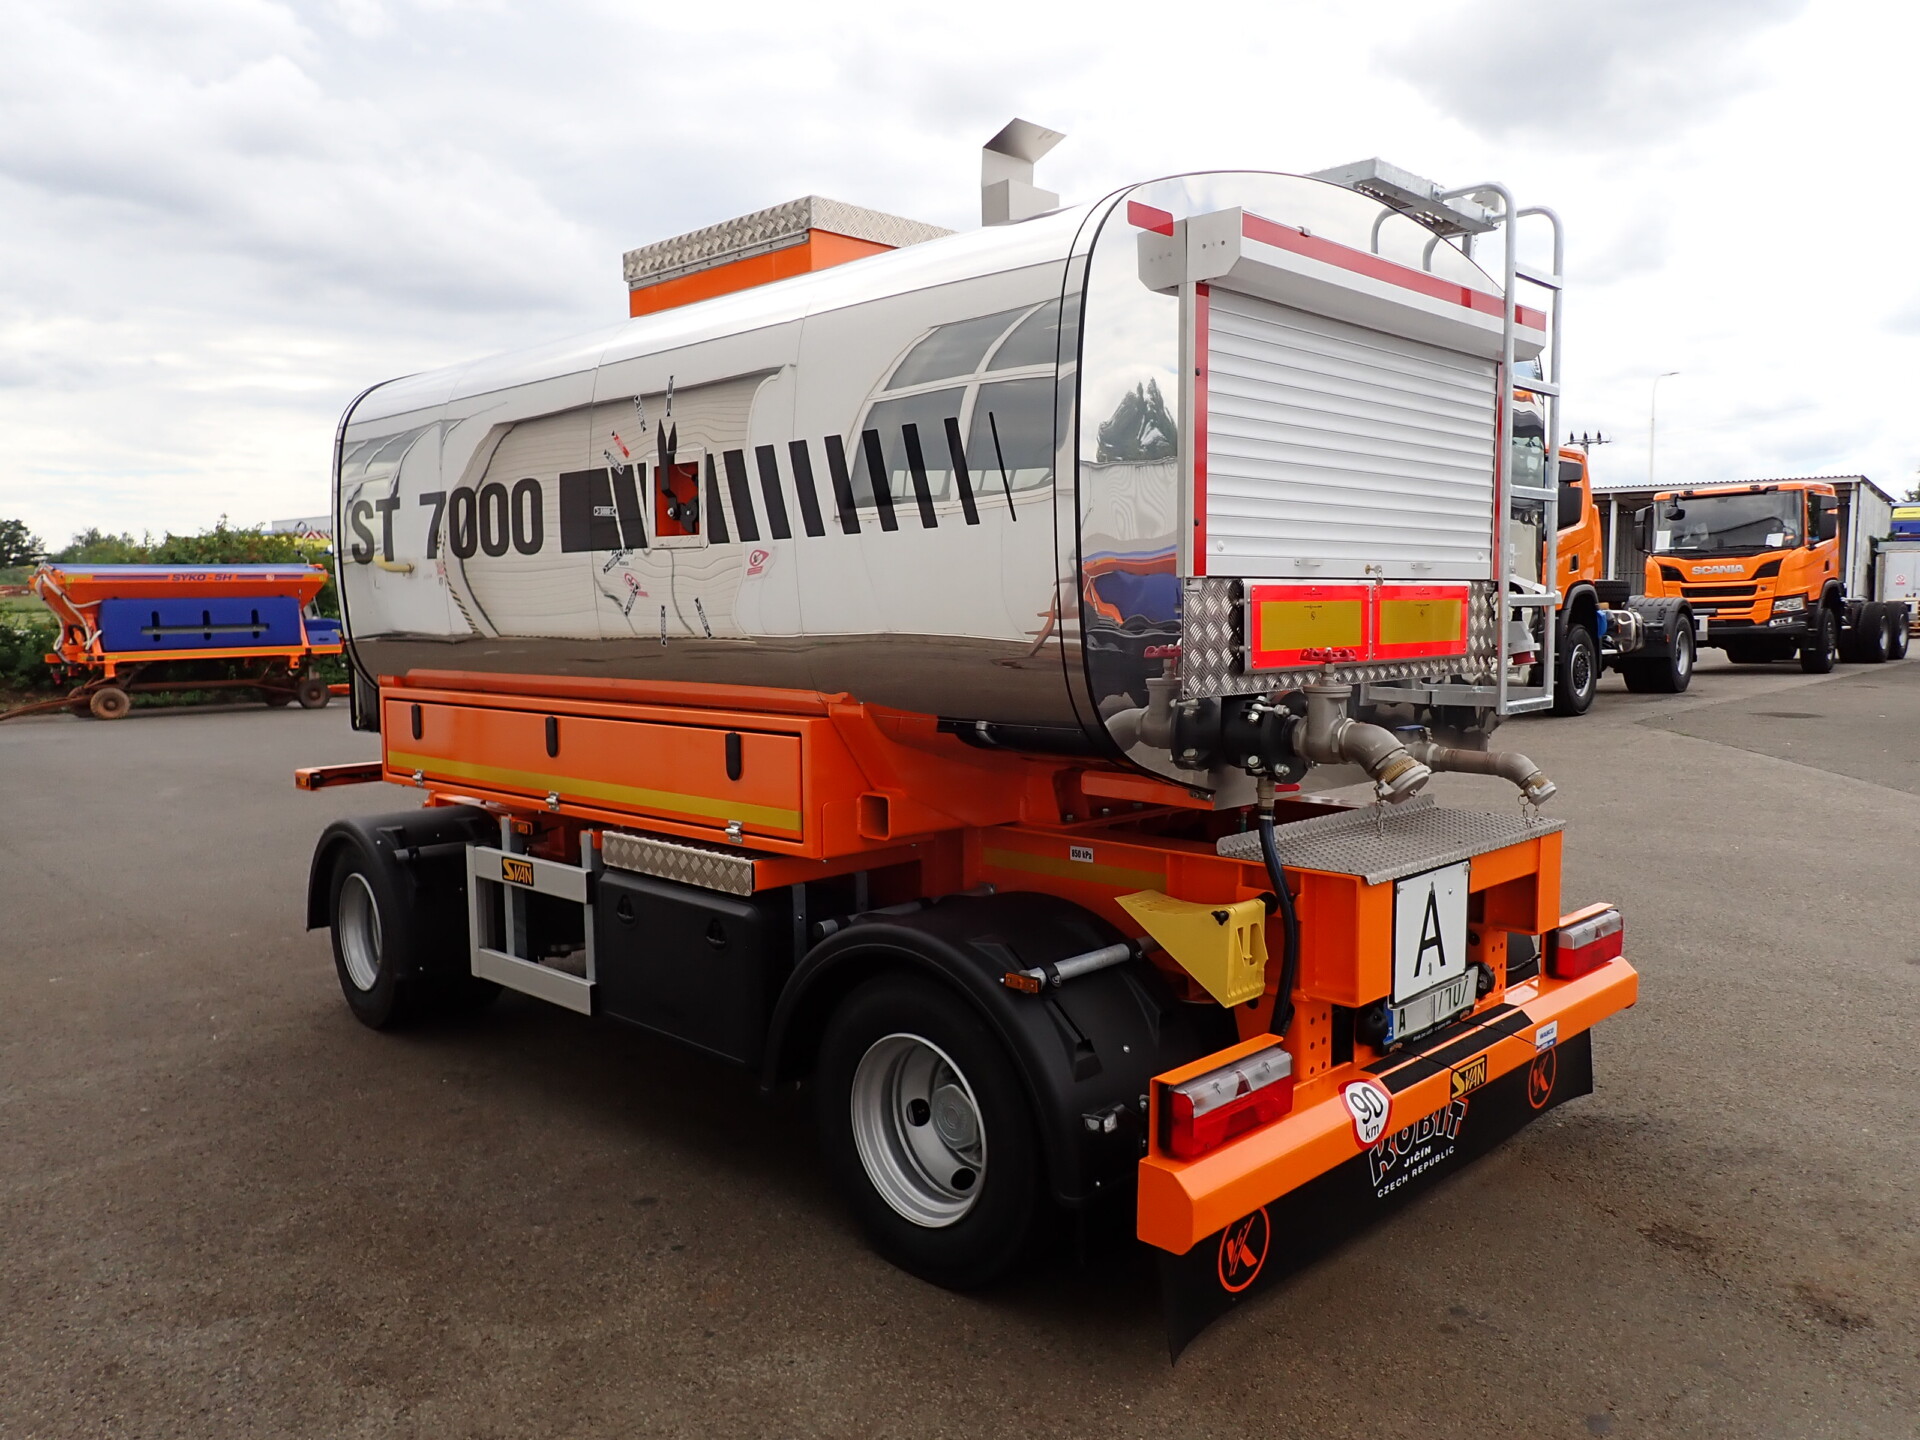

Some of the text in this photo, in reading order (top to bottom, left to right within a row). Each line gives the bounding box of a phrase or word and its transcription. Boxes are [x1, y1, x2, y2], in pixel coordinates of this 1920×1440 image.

[351, 478, 544, 565] ST 7000
[171, 573, 206, 581] SYKO
[1691, 564, 1745, 575] SCANIA
[1071, 849, 1092, 860] 850 kPa
[502, 858, 532, 885] SVAN
[1414, 881, 1446, 978] A
[1451, 1056, 1486, 1100] SVAN
[1349, 1086, 1384, 1125] 90
[1365, 1123, 1380, 1141] km
[1403, 1145, 1432, 1168] JIČÍN
[1377, 1145, 1455, 1198] CZECH REPUBLIC
